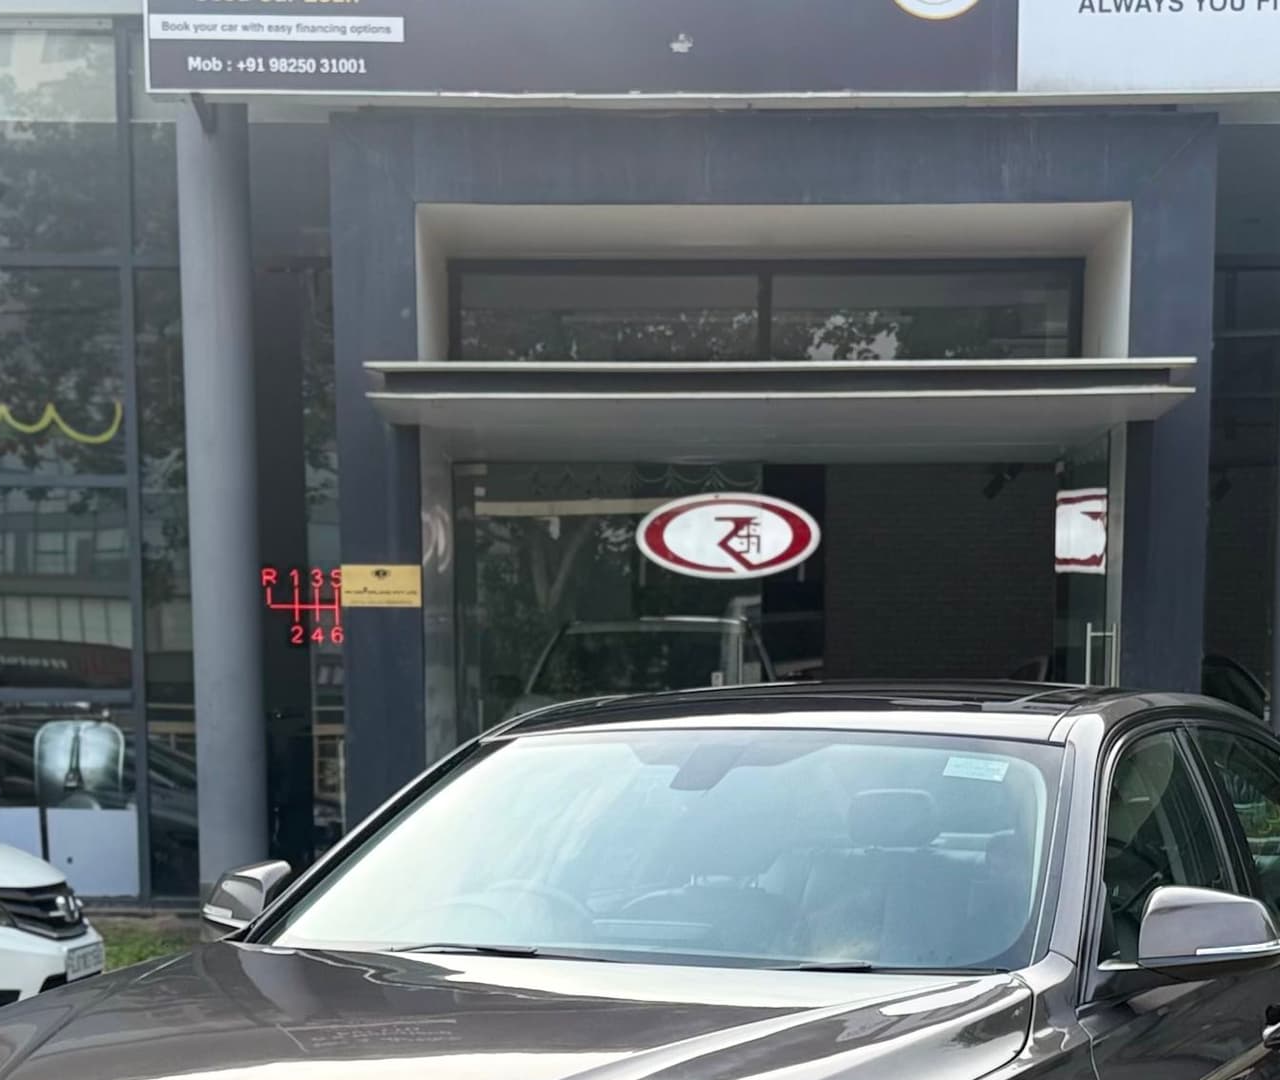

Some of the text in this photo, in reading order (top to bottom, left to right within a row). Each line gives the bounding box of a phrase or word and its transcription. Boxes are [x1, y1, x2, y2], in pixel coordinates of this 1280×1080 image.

[161, 20, 392, 36] Book your car with easy financing options
[187, 56, 223, 72] Mob
[237, 57, 265, 73] +91
[269, 57, 316, 73] 98250
[320, 58, 367, 74] 31001
[261, 567, 342, 588] R 1 3 5
[291, 625, 344, 645] 2 4 6
